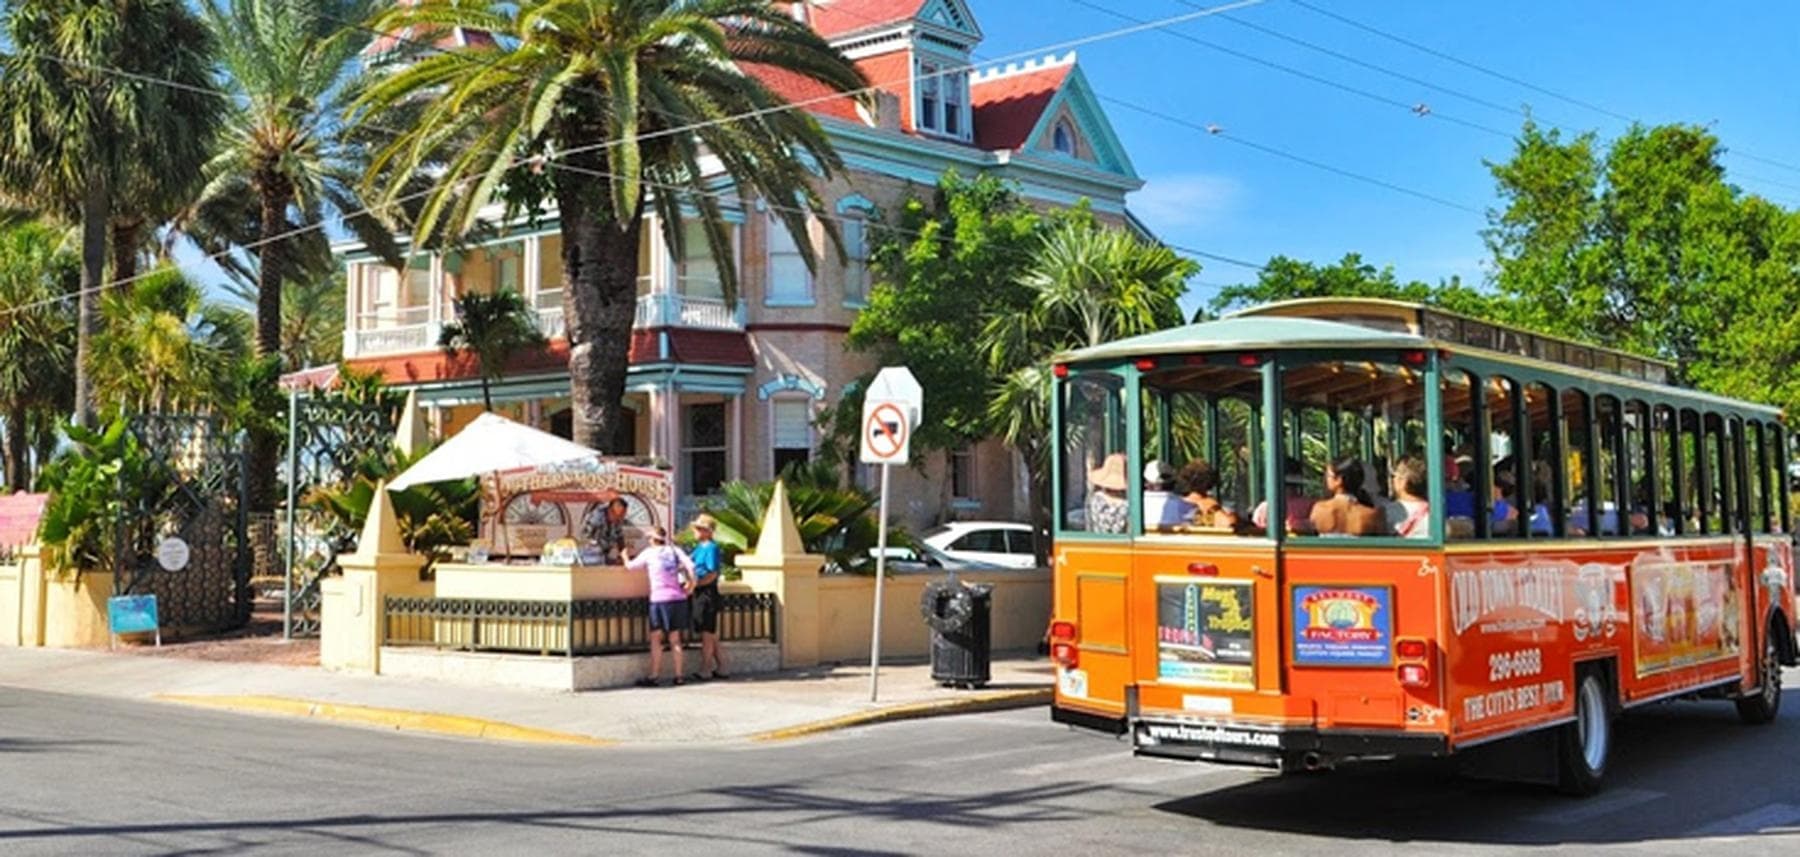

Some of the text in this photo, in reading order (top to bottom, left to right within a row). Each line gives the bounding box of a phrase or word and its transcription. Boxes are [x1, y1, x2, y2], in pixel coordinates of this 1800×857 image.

[1452, 570, 1479, 634] OLD
[1464, 695, 1485, 722] THE
[1517, 684, 1540, 711] BEST
